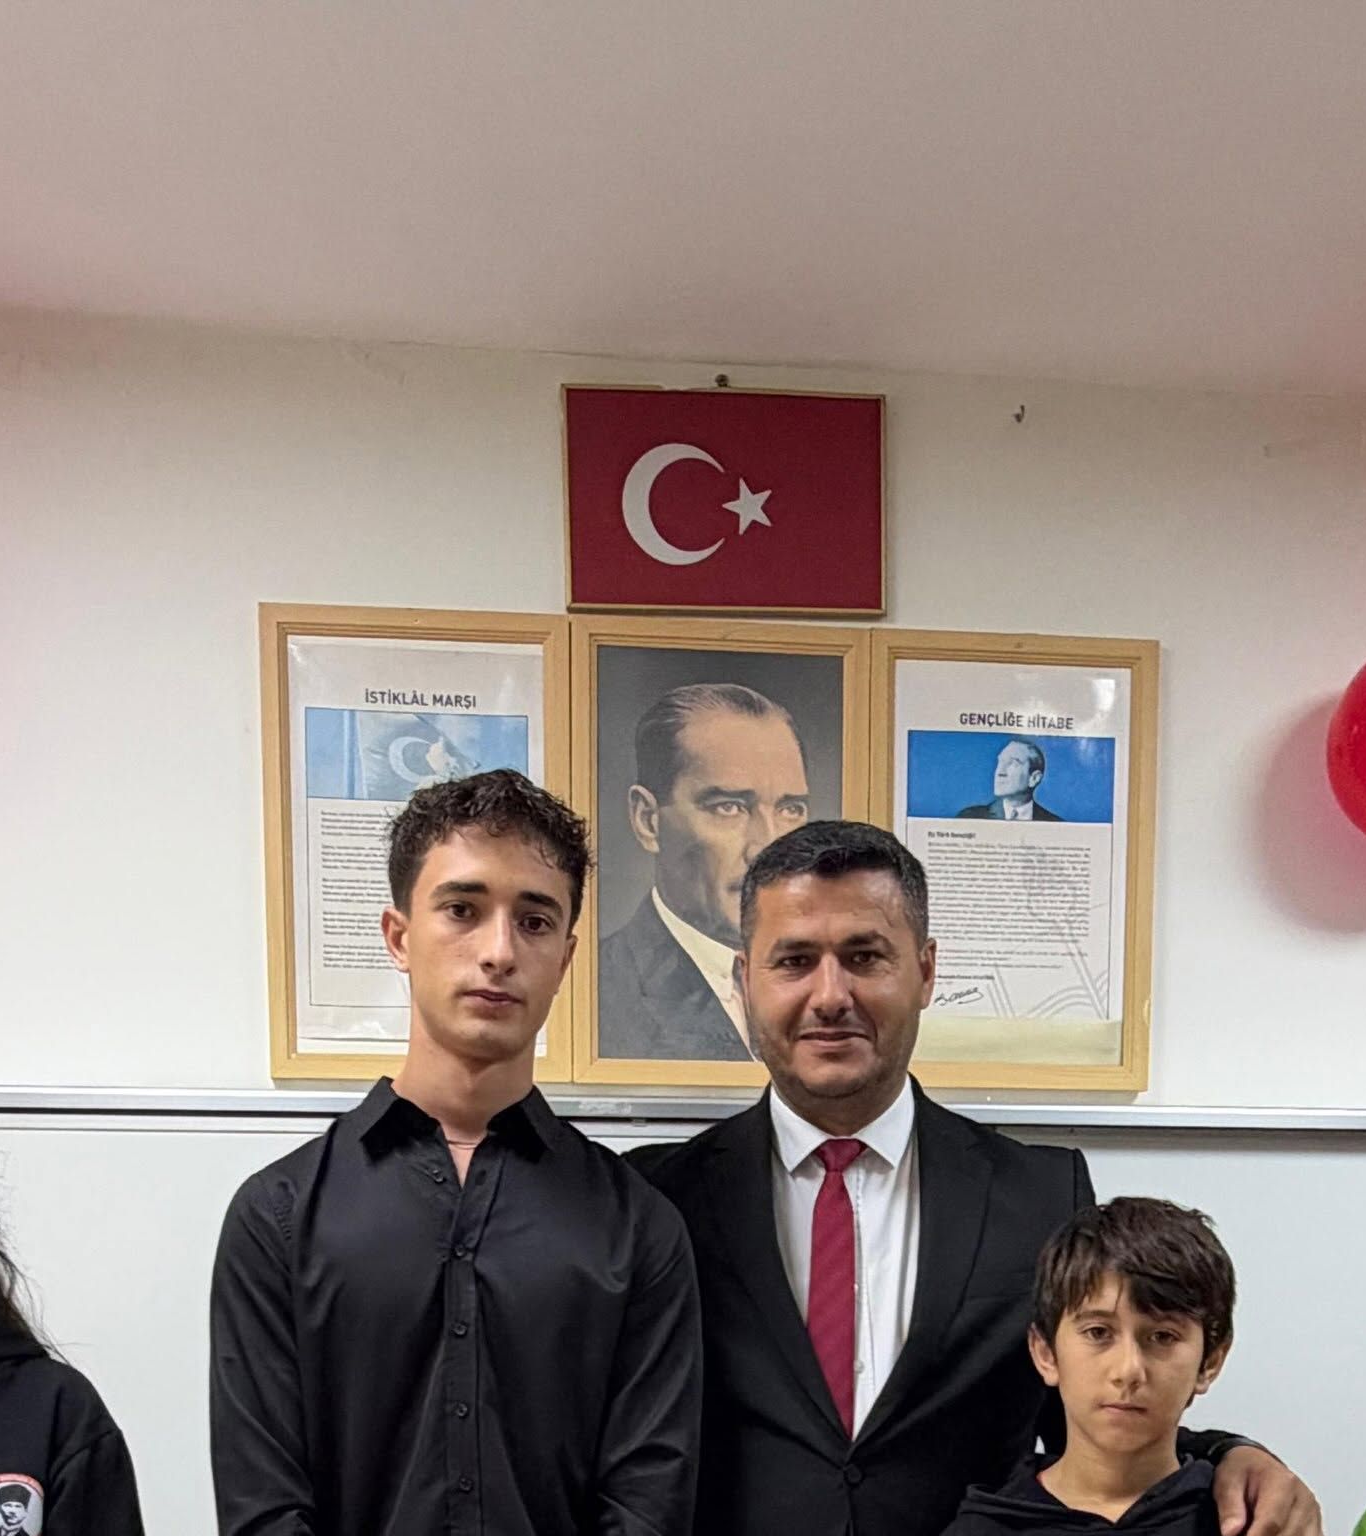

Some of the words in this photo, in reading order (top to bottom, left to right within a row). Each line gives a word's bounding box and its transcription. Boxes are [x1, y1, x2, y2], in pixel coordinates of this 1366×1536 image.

[432, 693, 477, 709] MARŞI
[959, 711, 1024, 727] GENÇLİĞE
[1027, 714, 1074, 729] HİTABE
